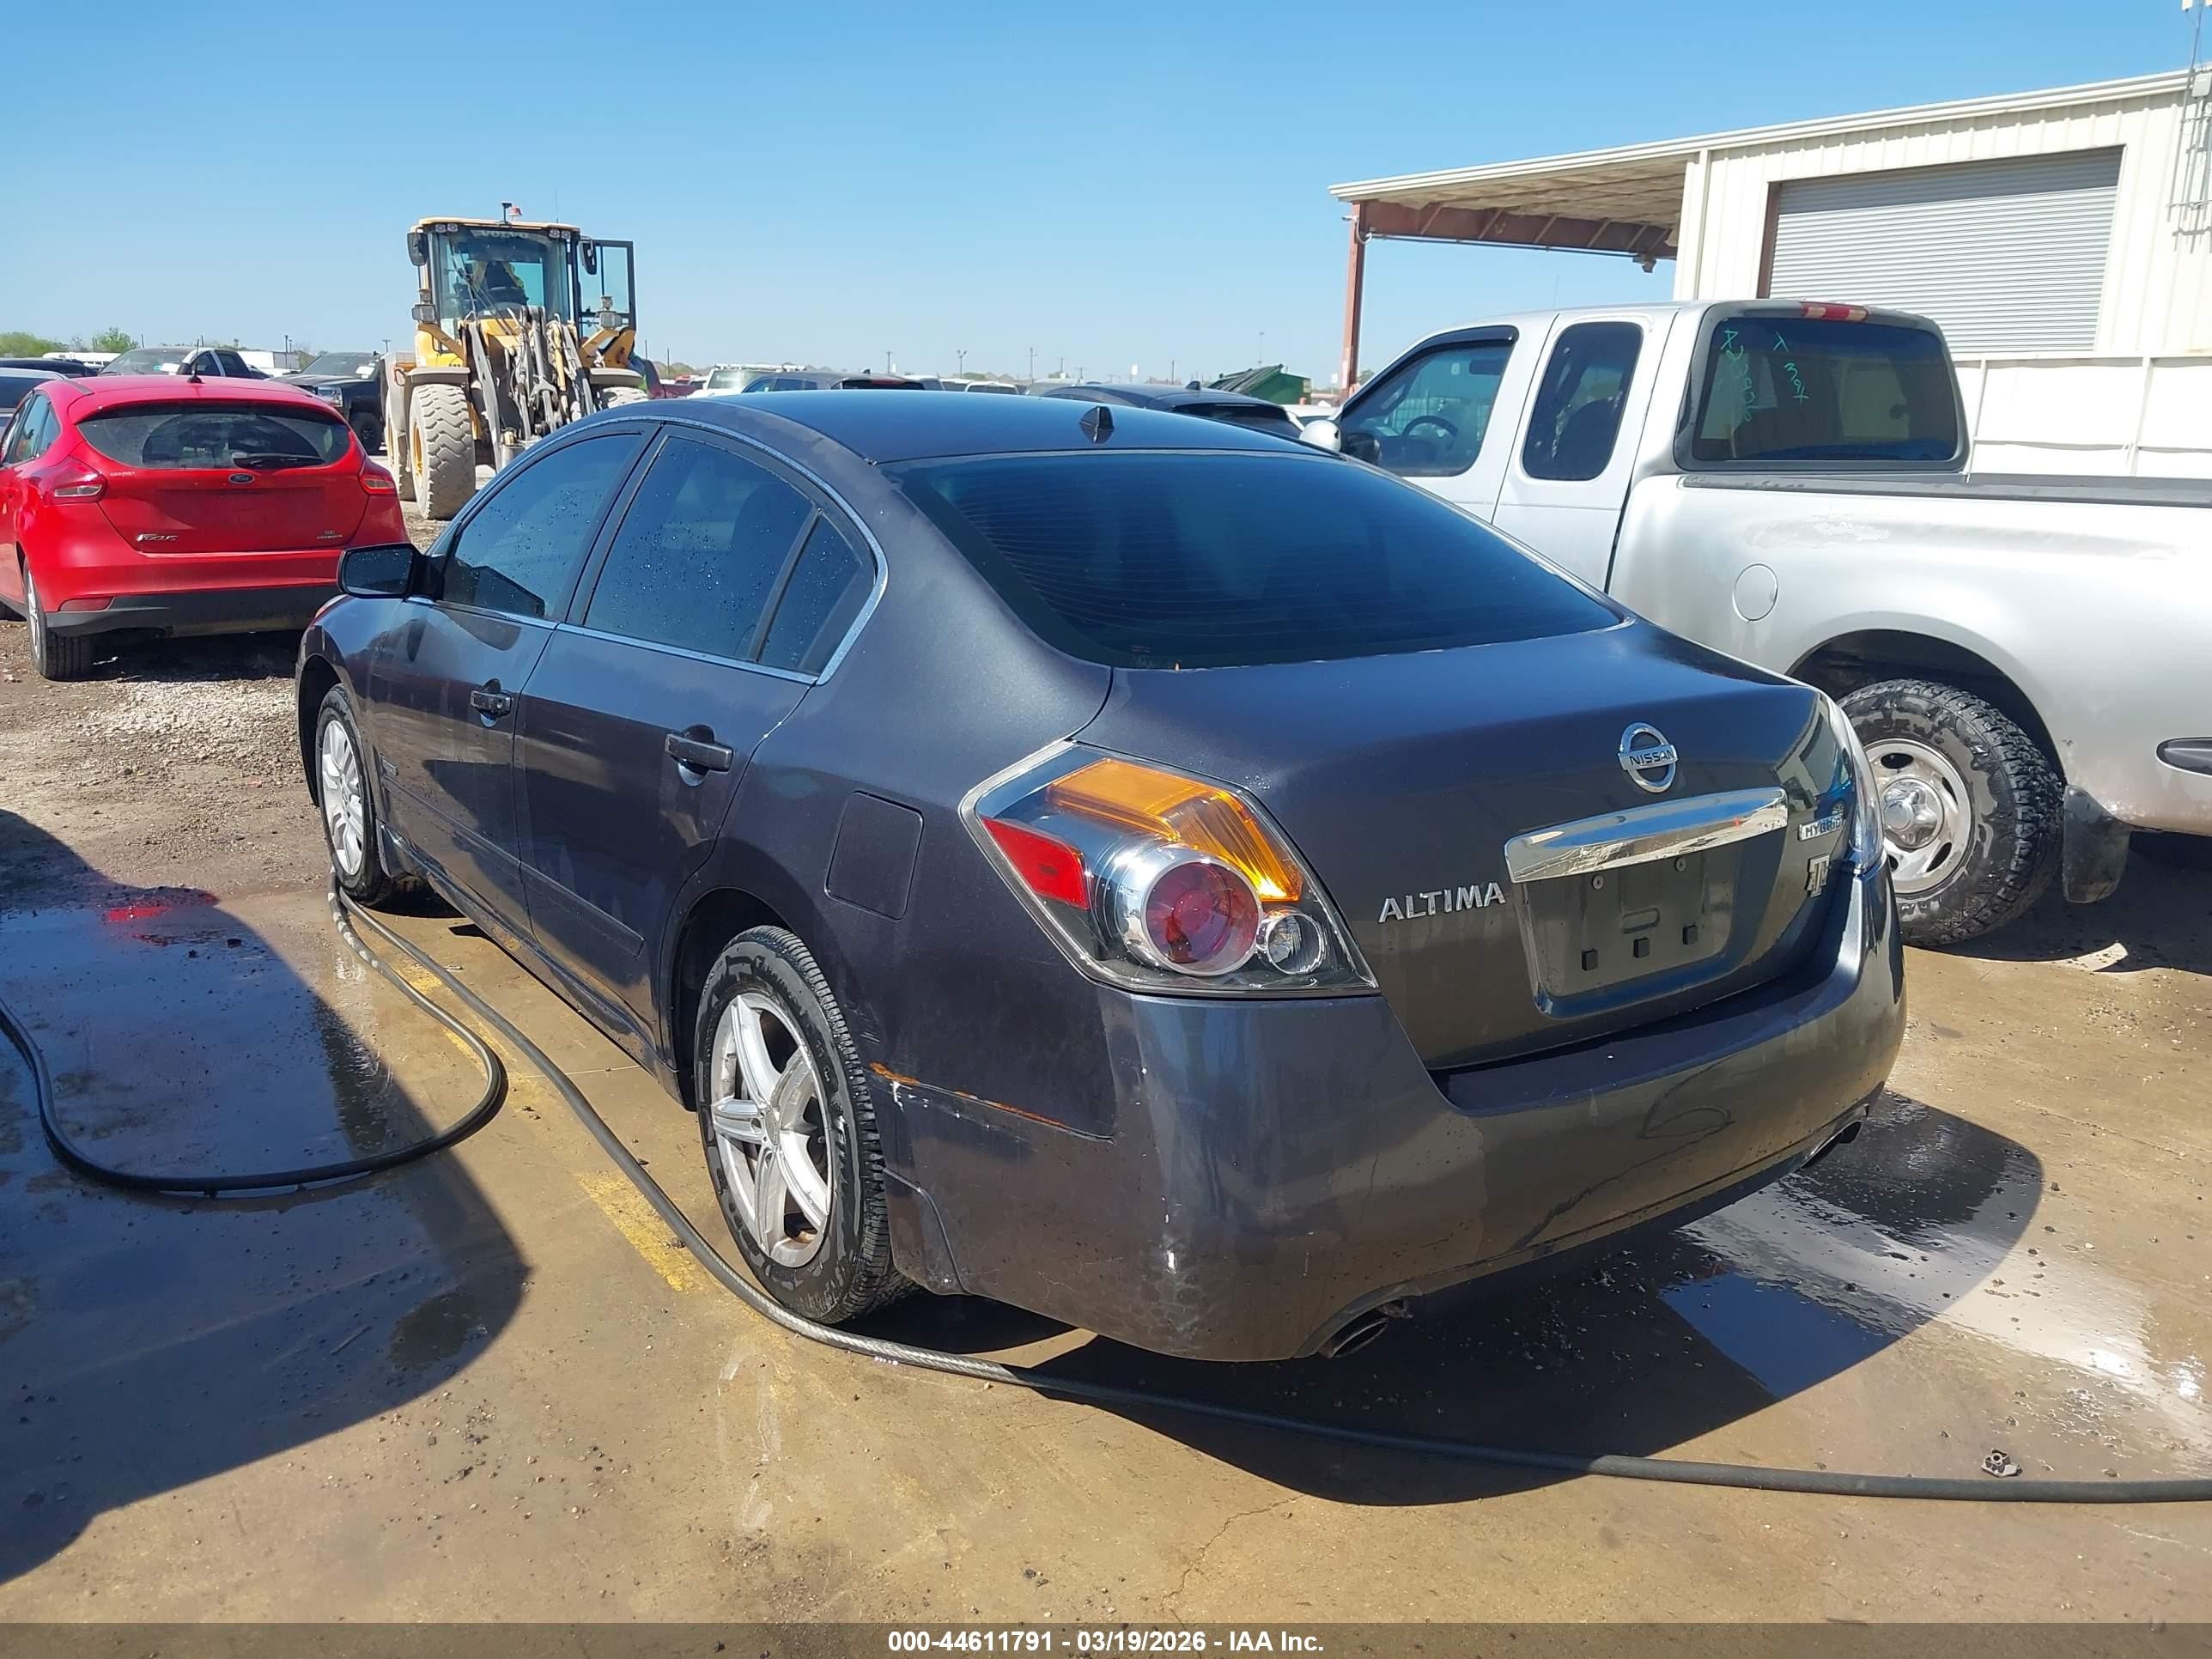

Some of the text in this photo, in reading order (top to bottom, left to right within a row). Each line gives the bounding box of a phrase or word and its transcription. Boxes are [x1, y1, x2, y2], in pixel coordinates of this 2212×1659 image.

[481, 230, 530, 240] VOLVO
[1629, 749, 1675, 765] NISSAN
[1377, 881, 1506, 923] ALTIMA
